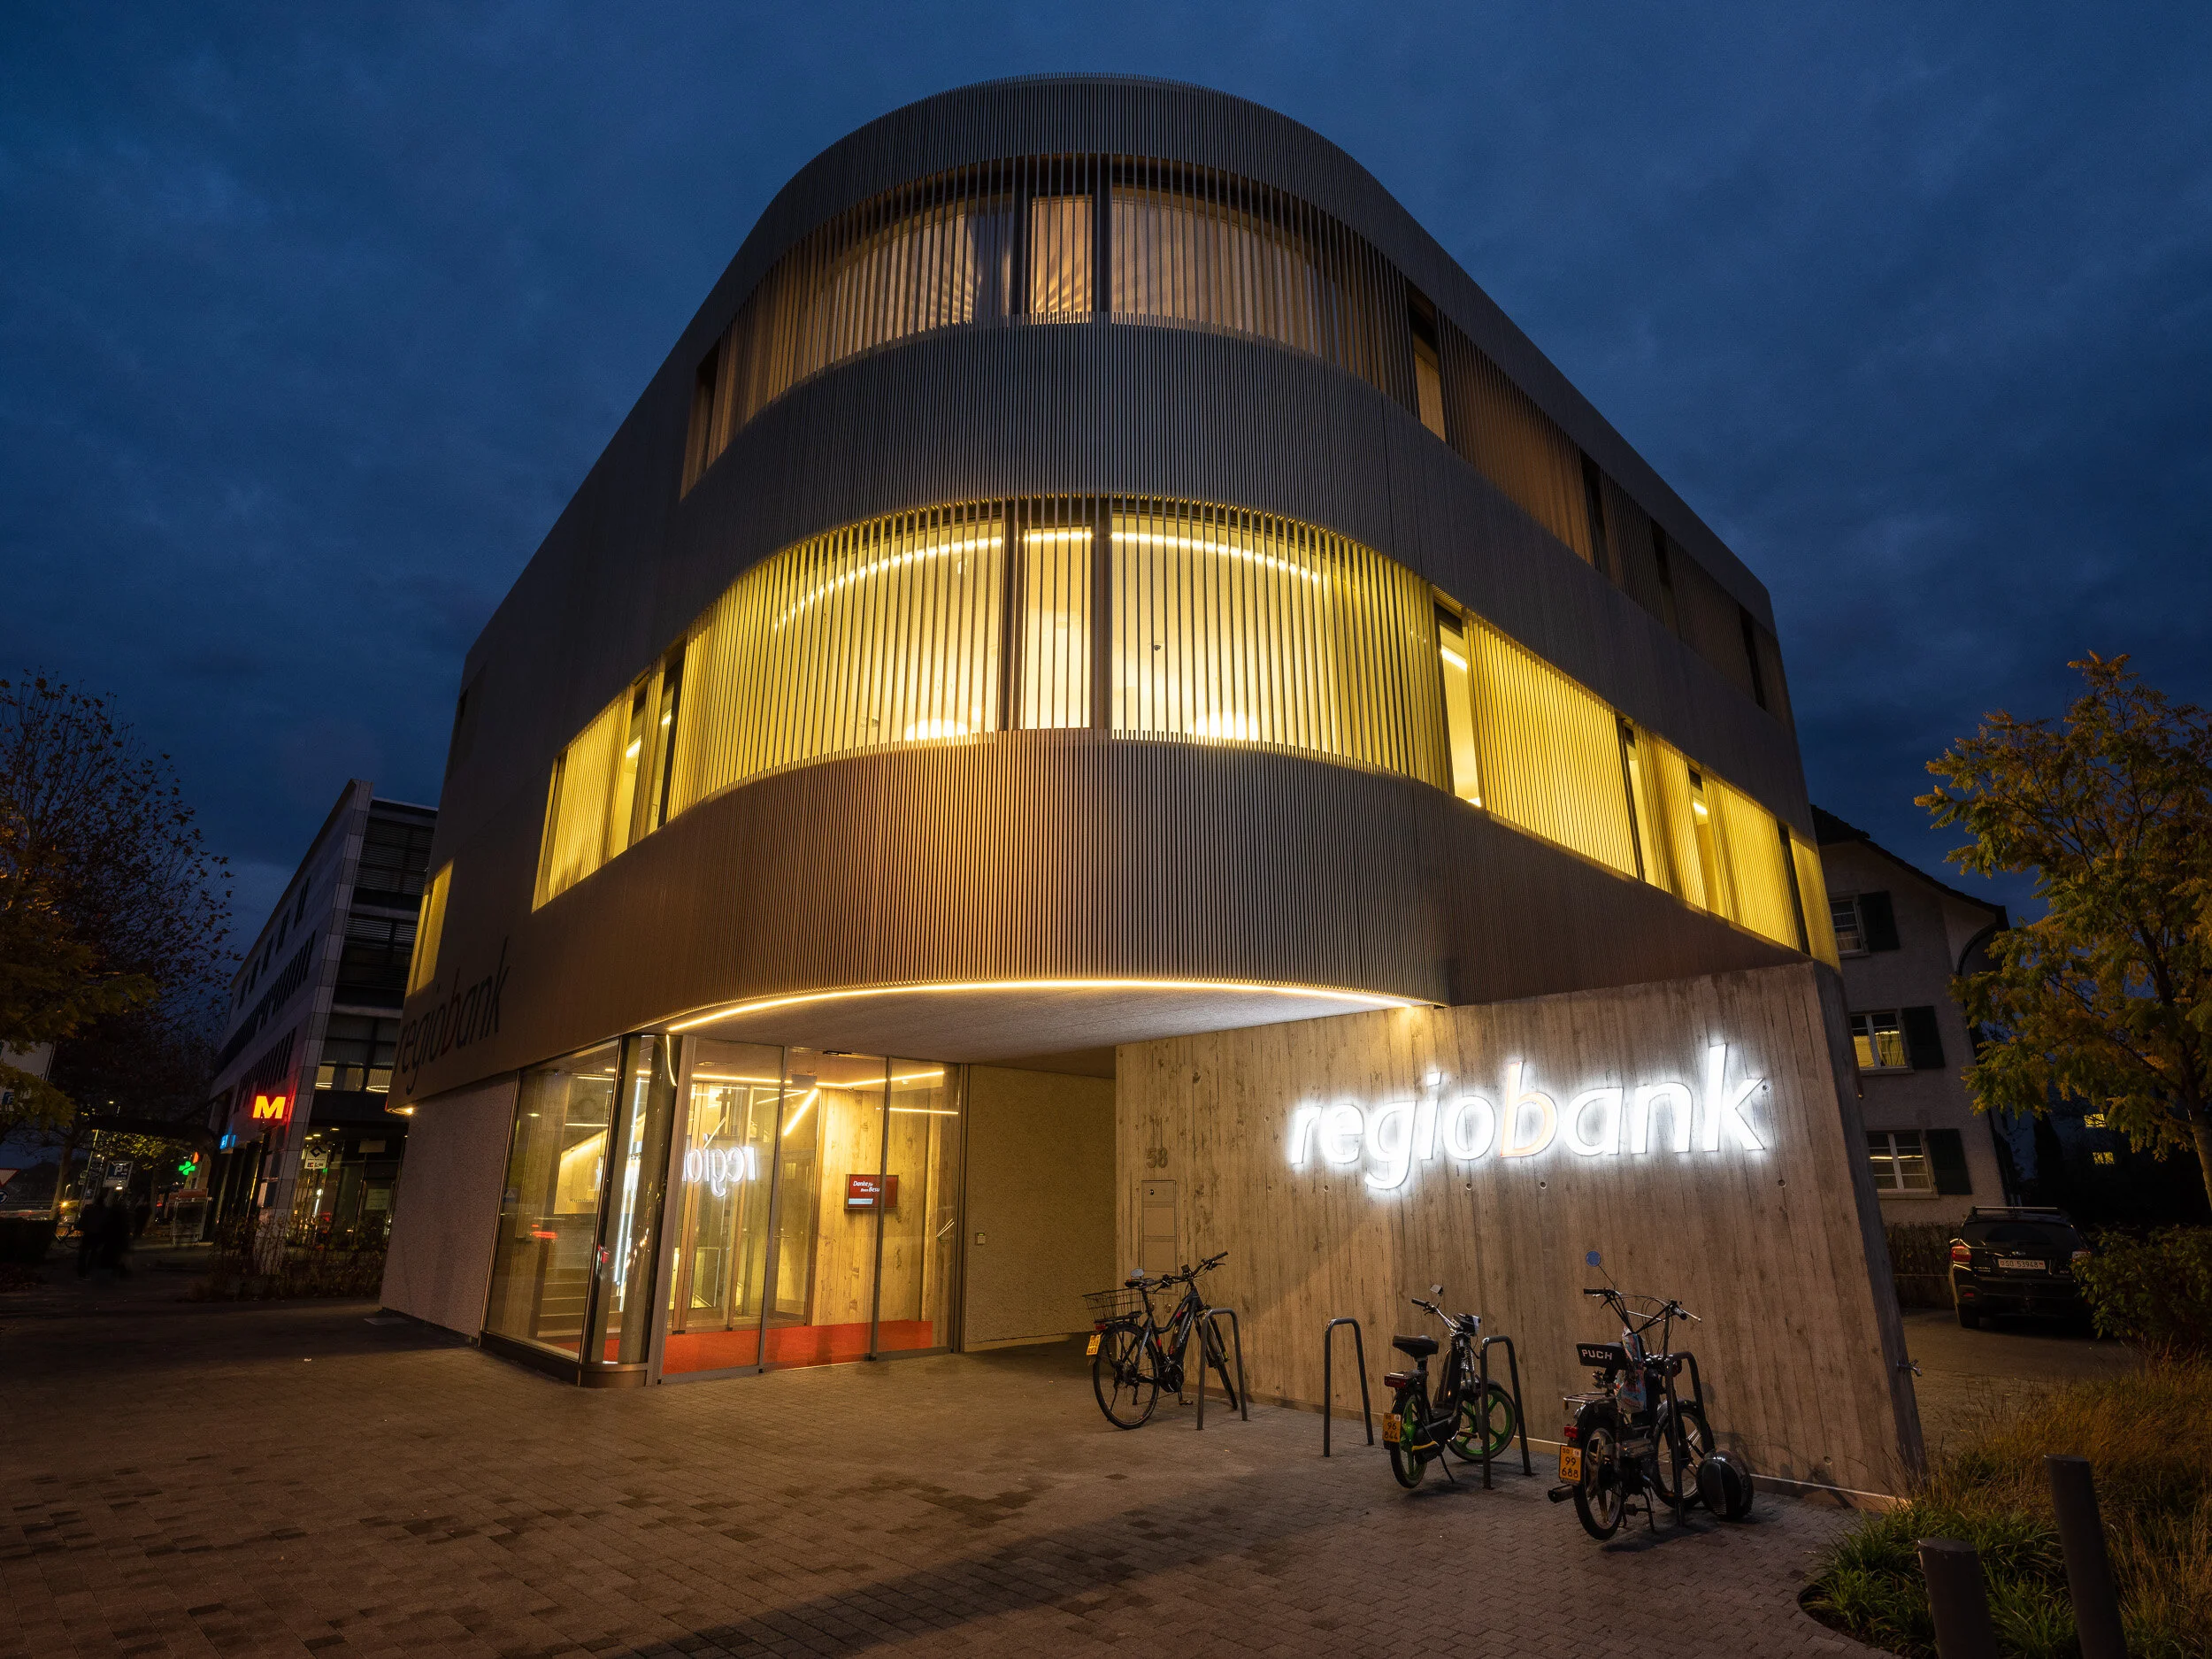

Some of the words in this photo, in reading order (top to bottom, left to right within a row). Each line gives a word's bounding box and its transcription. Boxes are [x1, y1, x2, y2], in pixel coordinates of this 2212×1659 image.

[393, 935, 511, 1095] regiobank
[253, 1096, 286, 1118] M
[1290, 1043, 1765, 1189] regiobank
[1146, 1147, 1168, 1168] 58
[1581, 1349, 1612, 1360] PUCH
[1565, 1456, 1576, 1466] 99
[1562, 1467, 1578, 1478] 688
